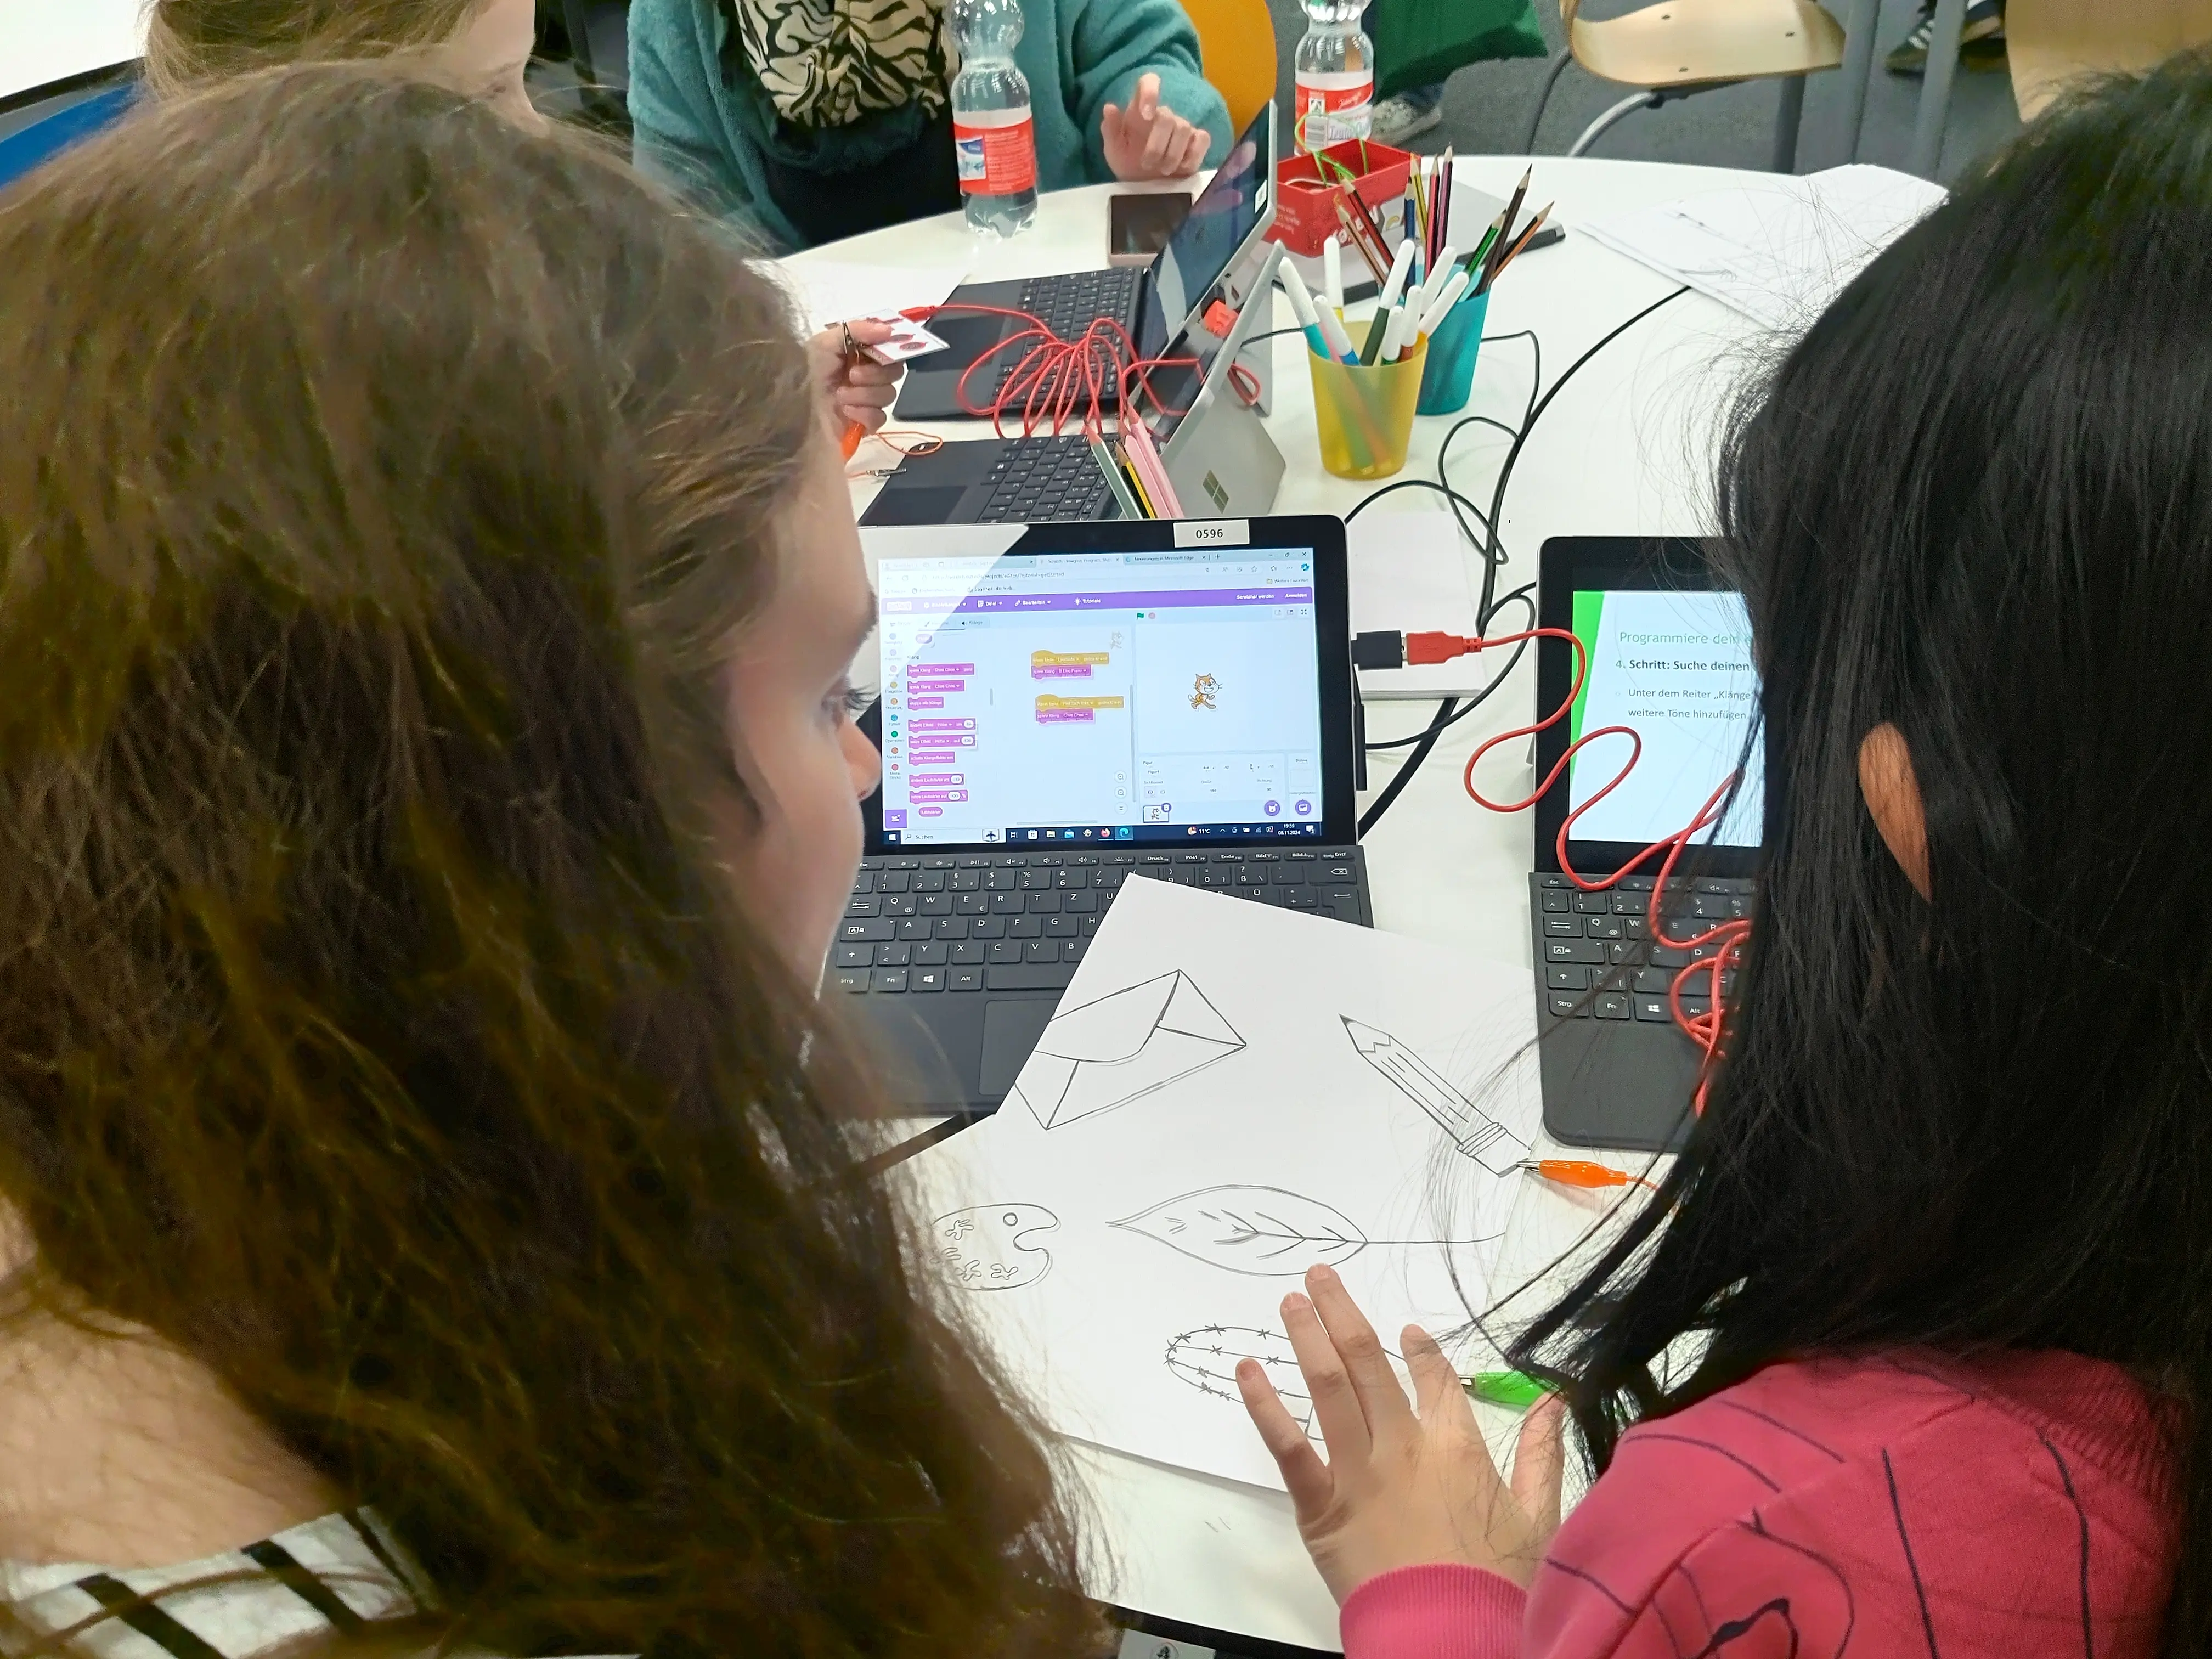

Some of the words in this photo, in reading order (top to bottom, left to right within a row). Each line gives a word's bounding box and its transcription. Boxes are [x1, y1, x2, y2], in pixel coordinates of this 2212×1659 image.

[1196, 529, 1223, 539] 0596
[1620, 632, 1708, 645] Programmiere
[1616, 660, 1626, 669] 4.
[1629, 660, 1670, 669] Schritt:
[1673, 661, 1707, 670] Suche
[1711, 661, 1750, 672] deinen
[1629, 689, 1655, 697] Unter
[1658, 689, 1679, 698] dem
[1683, 690, 1711, 698] Reiter
[1628, 709, 1664, 717] weitere
[1668, 709, 1690, 718] Töne
